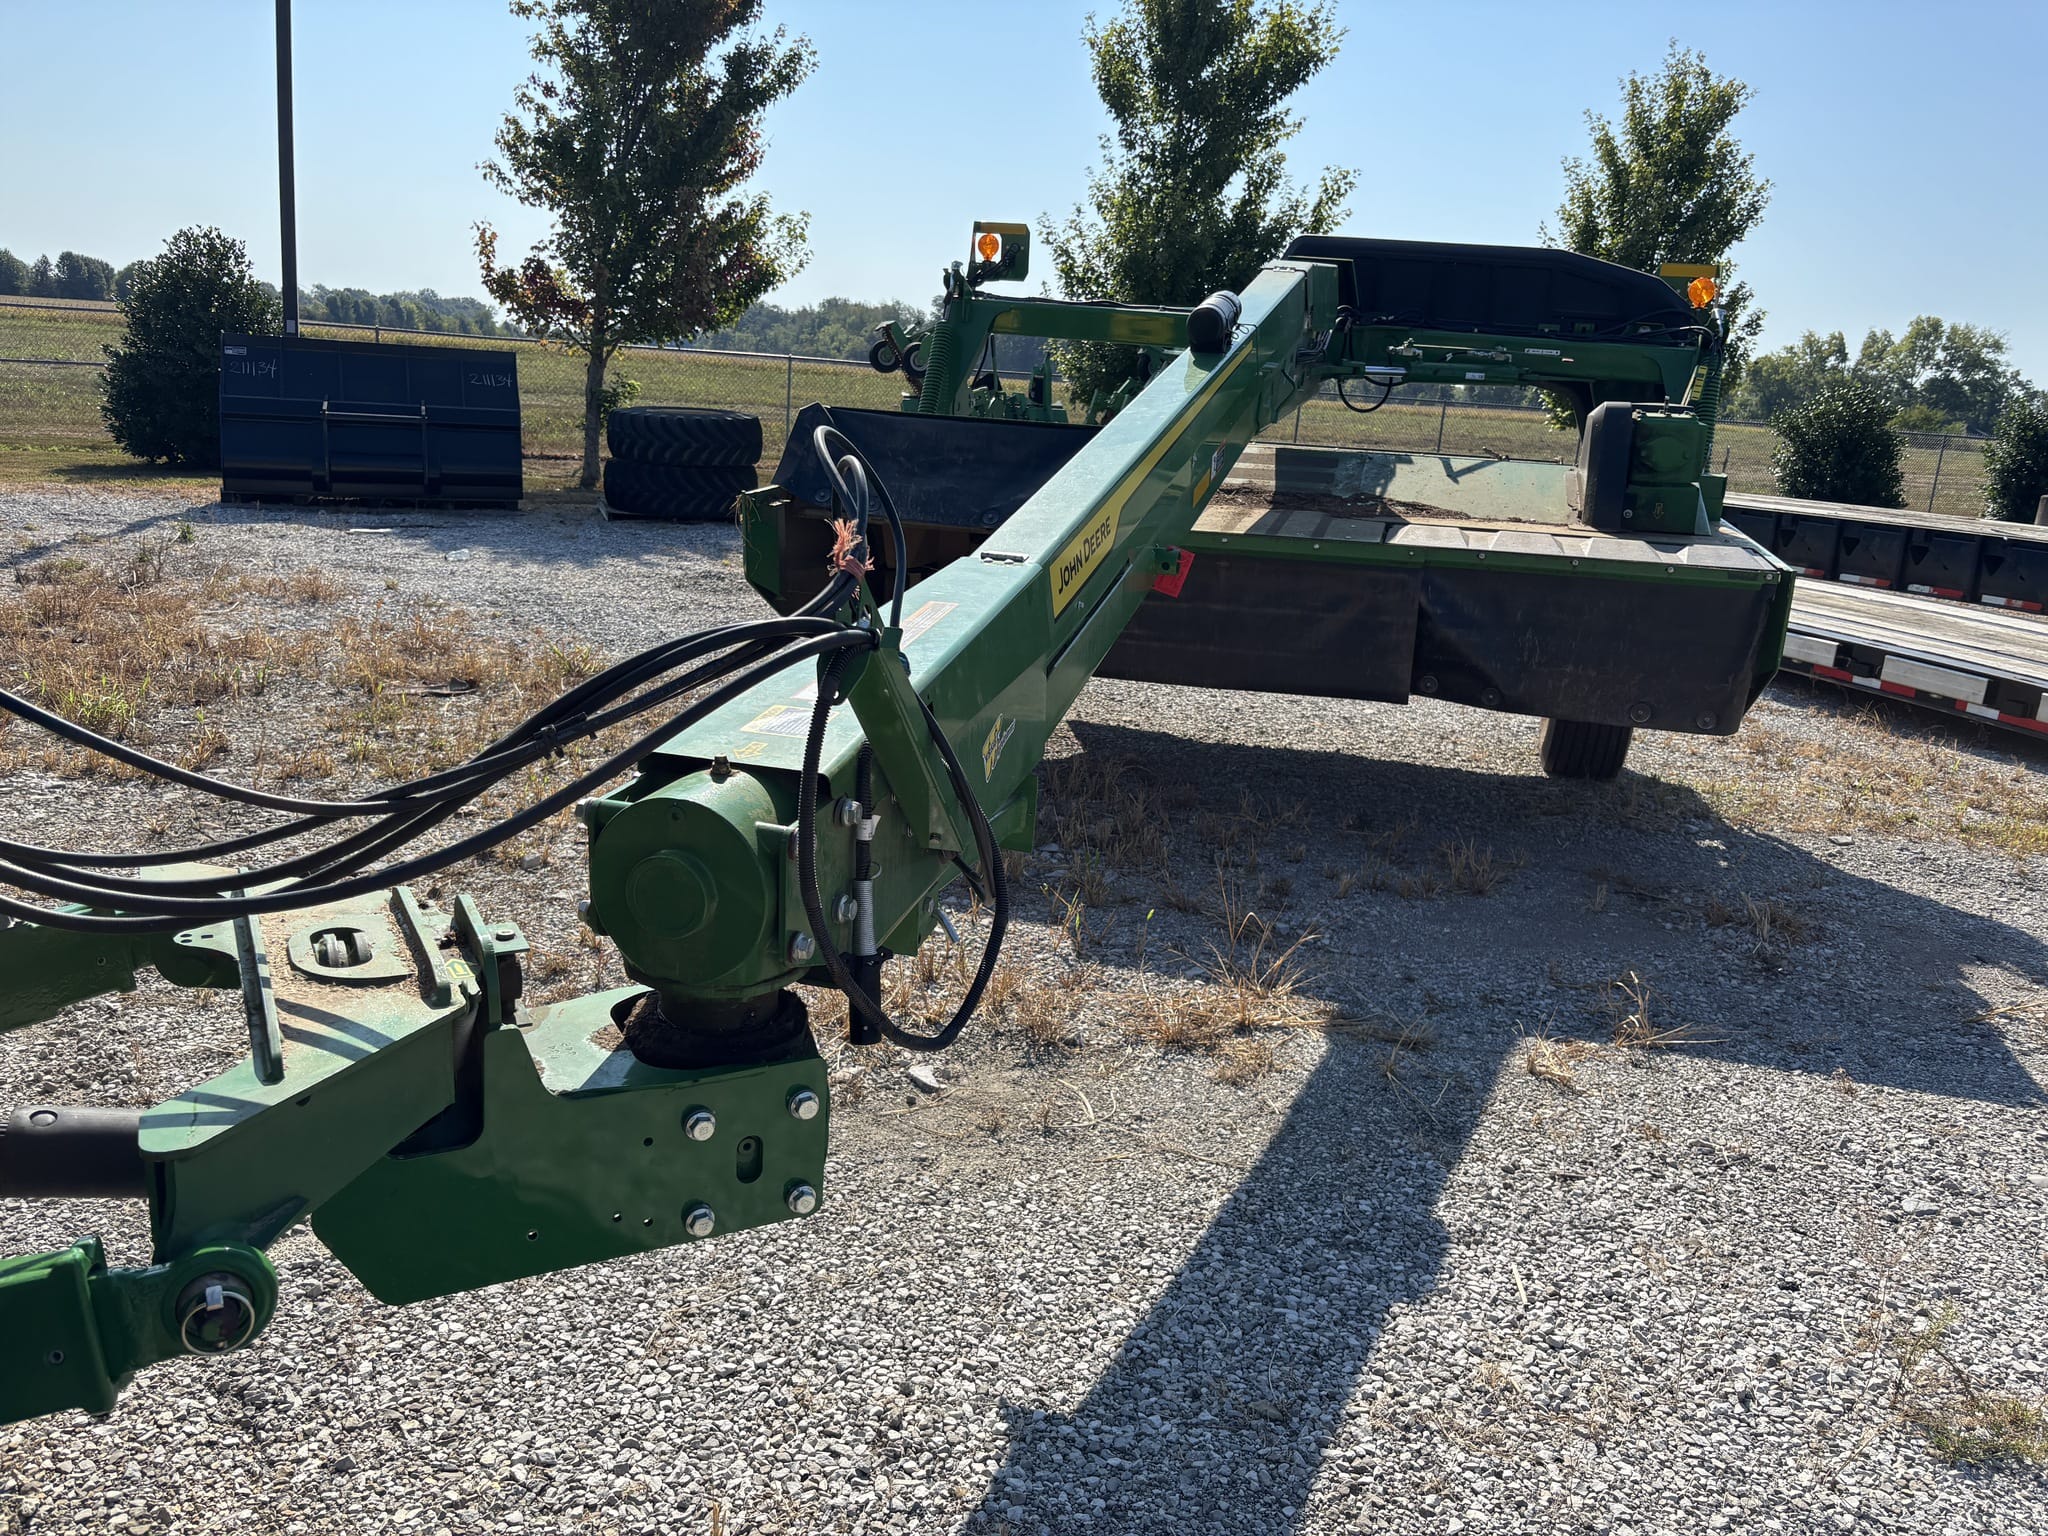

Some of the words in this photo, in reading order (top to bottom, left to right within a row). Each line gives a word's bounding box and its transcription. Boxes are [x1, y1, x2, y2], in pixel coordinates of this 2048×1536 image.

[230, 359, 277, 378] 211134
[469, 373, 512, 387] 211134
[1058, 549, 1083, 594] JOHN
[1083, 515, 1112, 563] DEERE
